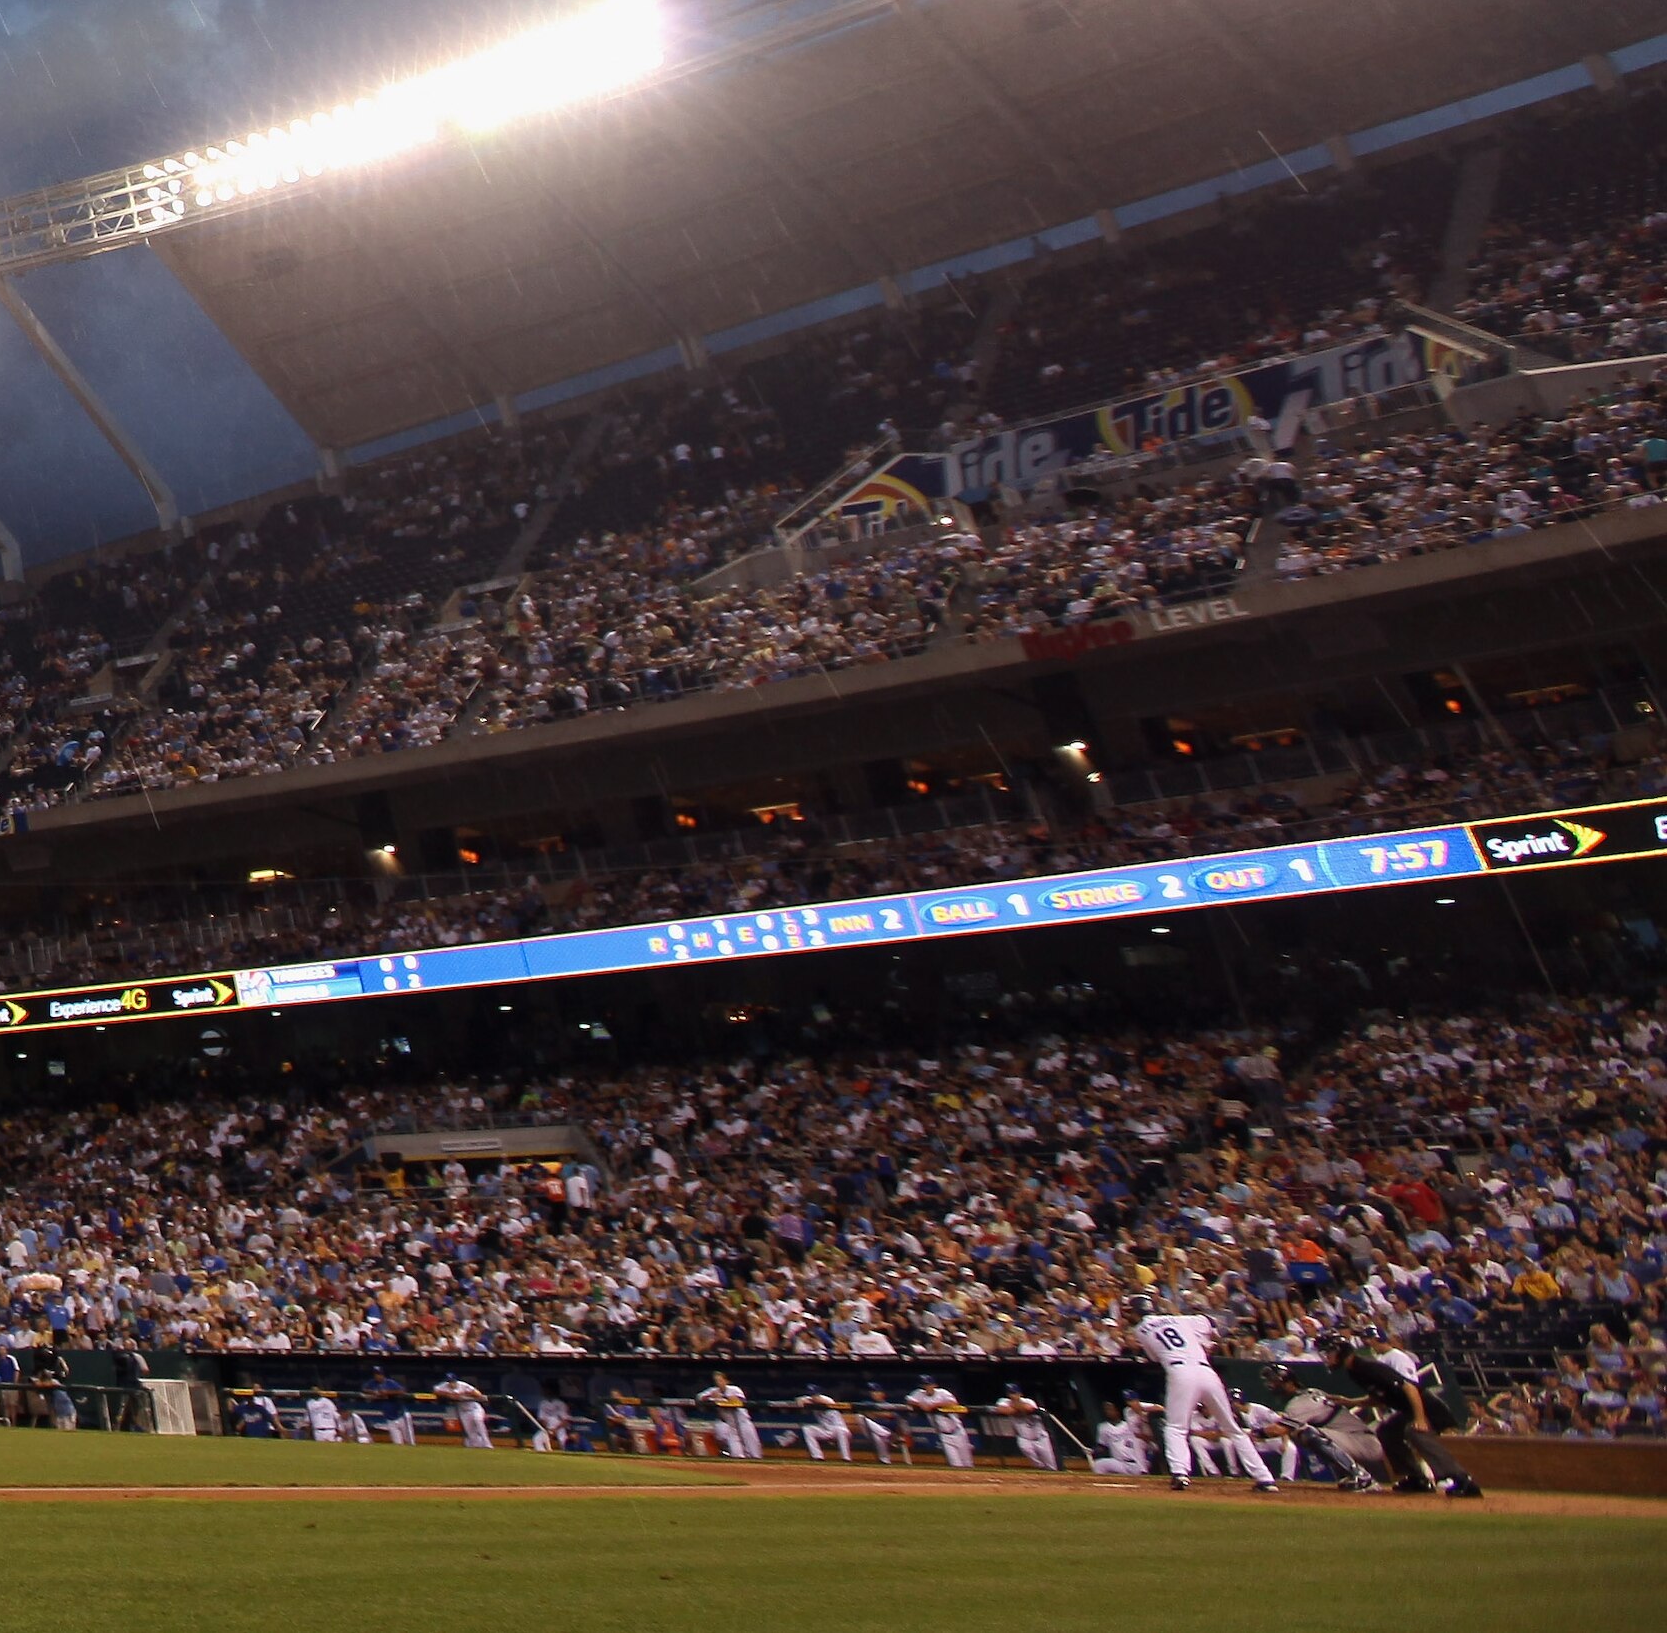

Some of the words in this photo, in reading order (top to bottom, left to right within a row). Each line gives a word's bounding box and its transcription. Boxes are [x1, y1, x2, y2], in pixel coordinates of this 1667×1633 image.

[1113, 387, 1233, 452] Tide
[921, 429, 1057, 498] Tide
[1149, 598, 1250, 631] LEVEL
[1359, 839, 1449, 875] 7:57
[1486, 831, 1570, 862] Sprint
[1205, 867, 1266, 889] OUT
[1289, 859, 1315, 882] 1
[1049, 883, 1145, 912] STRIKE
[1157, 875, 1186, 899] 2
[829, 915, 874, 933] INN
[879, 909, 904, 930] 2
[932, 901, 999, 924] BALL
[1006, 894, 1030, 917] 1
[669, 924, 685, 940] 0
[712, 920, 728, 935] 1
[756, 914, 775, 930] 0
[649, 937, 666, 953] R
[692, 932, 713, 948] H
[738, 926, 756, 943] E
[762, 935, 781, 951] 0
[673, 944, 690, 960] 2
[172, 987, 215, 1008] Sprint
[1155, 1327, 1185, 1351] 18
